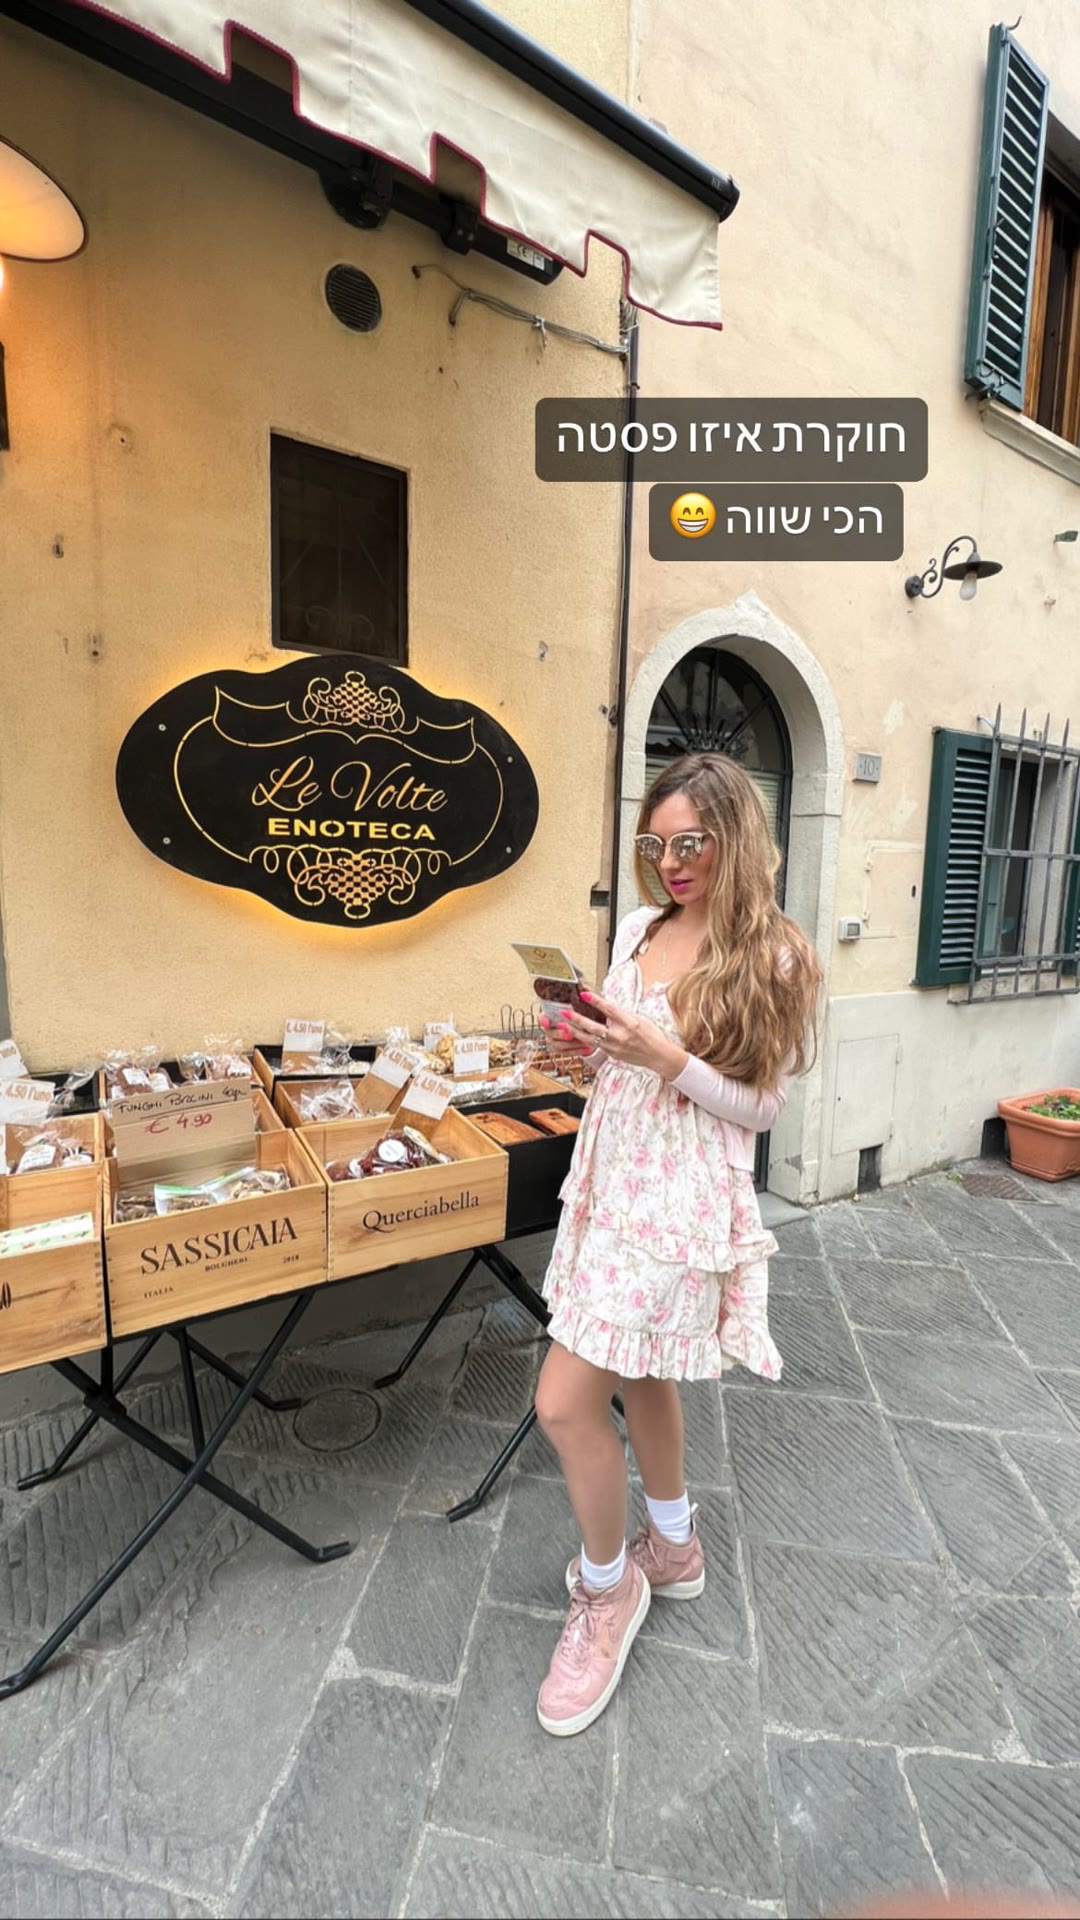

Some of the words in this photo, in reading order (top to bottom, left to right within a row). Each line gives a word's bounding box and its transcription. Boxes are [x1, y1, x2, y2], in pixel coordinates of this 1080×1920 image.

[252, 755, 323, 812] Le
[331, 761, 448, 812] Volte
[268, 818, 436, 841] ENOTECA
[114, 1100, 162, 1113] FUNGHI
[145, 1115, 169, 1133] €
[363, 1191, 480, 1233] Querciabella
[141, 1217, 297, 1275] SASSICAIA
[144, 1286, 174, 1298] ITALIA
